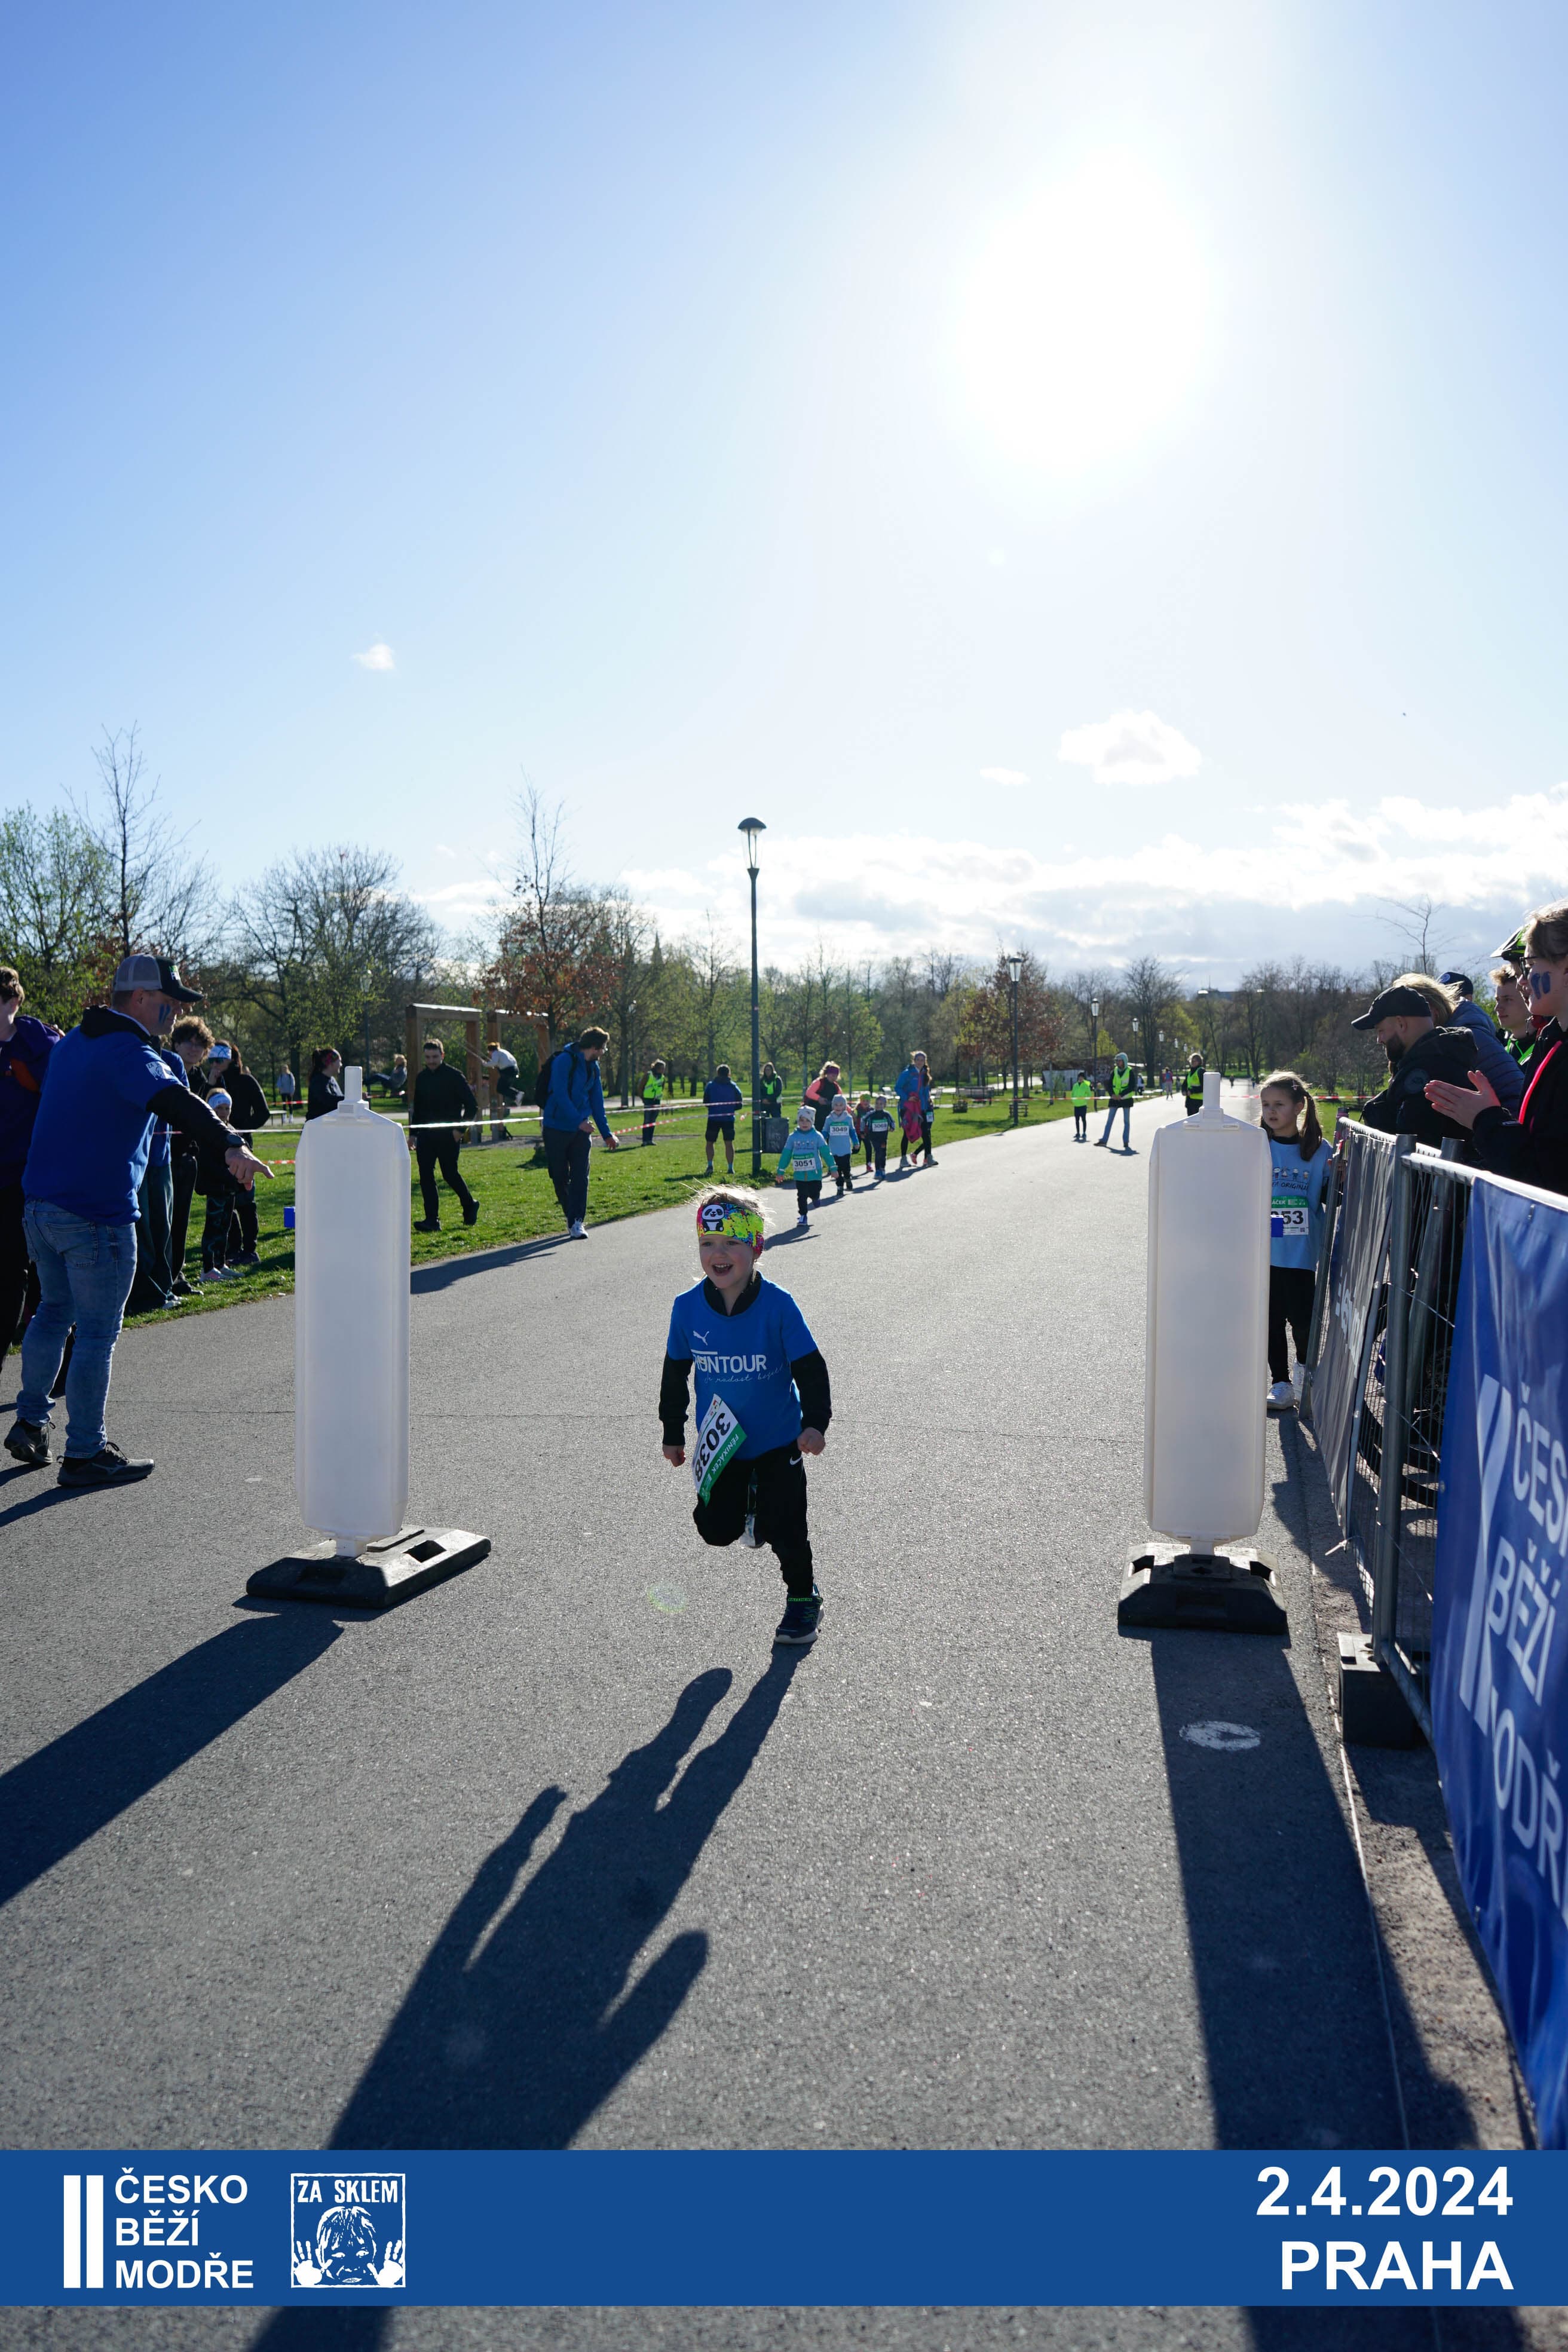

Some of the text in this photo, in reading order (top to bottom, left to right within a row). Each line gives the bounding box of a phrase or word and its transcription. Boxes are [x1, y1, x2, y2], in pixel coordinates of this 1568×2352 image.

[695, 1413, 731, 1483] 3038
[1512, 1381, 1568, 1557] ČES
[1487, 1535, 1561, 1707] BĚŽÍ
[1491, 1684, 1568, 1930] ODŘ
